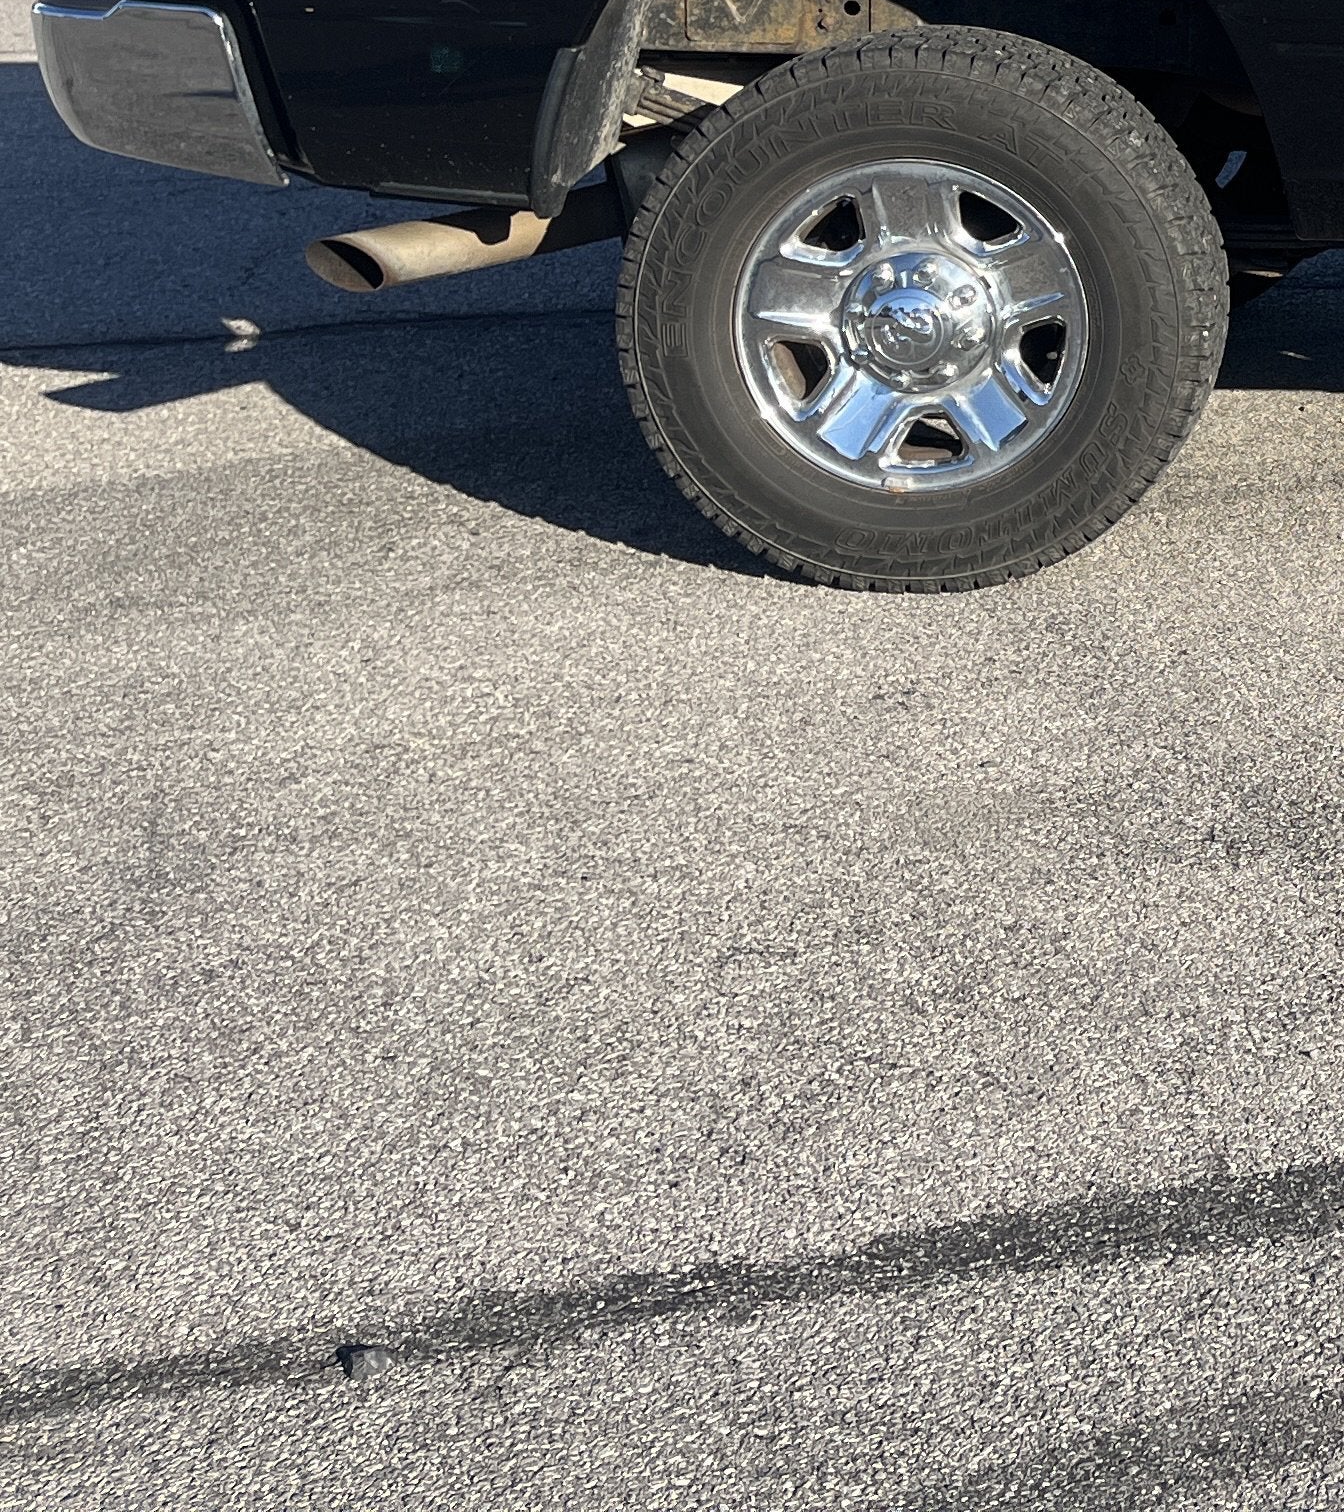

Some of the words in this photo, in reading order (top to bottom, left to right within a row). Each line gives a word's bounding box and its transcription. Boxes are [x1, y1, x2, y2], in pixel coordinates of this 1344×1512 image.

[660, 99, 957, 359] ENCOUNTER
[980, 126, 1068, 173] AT
[834, 400, 1130, 556] SUMITOMO
